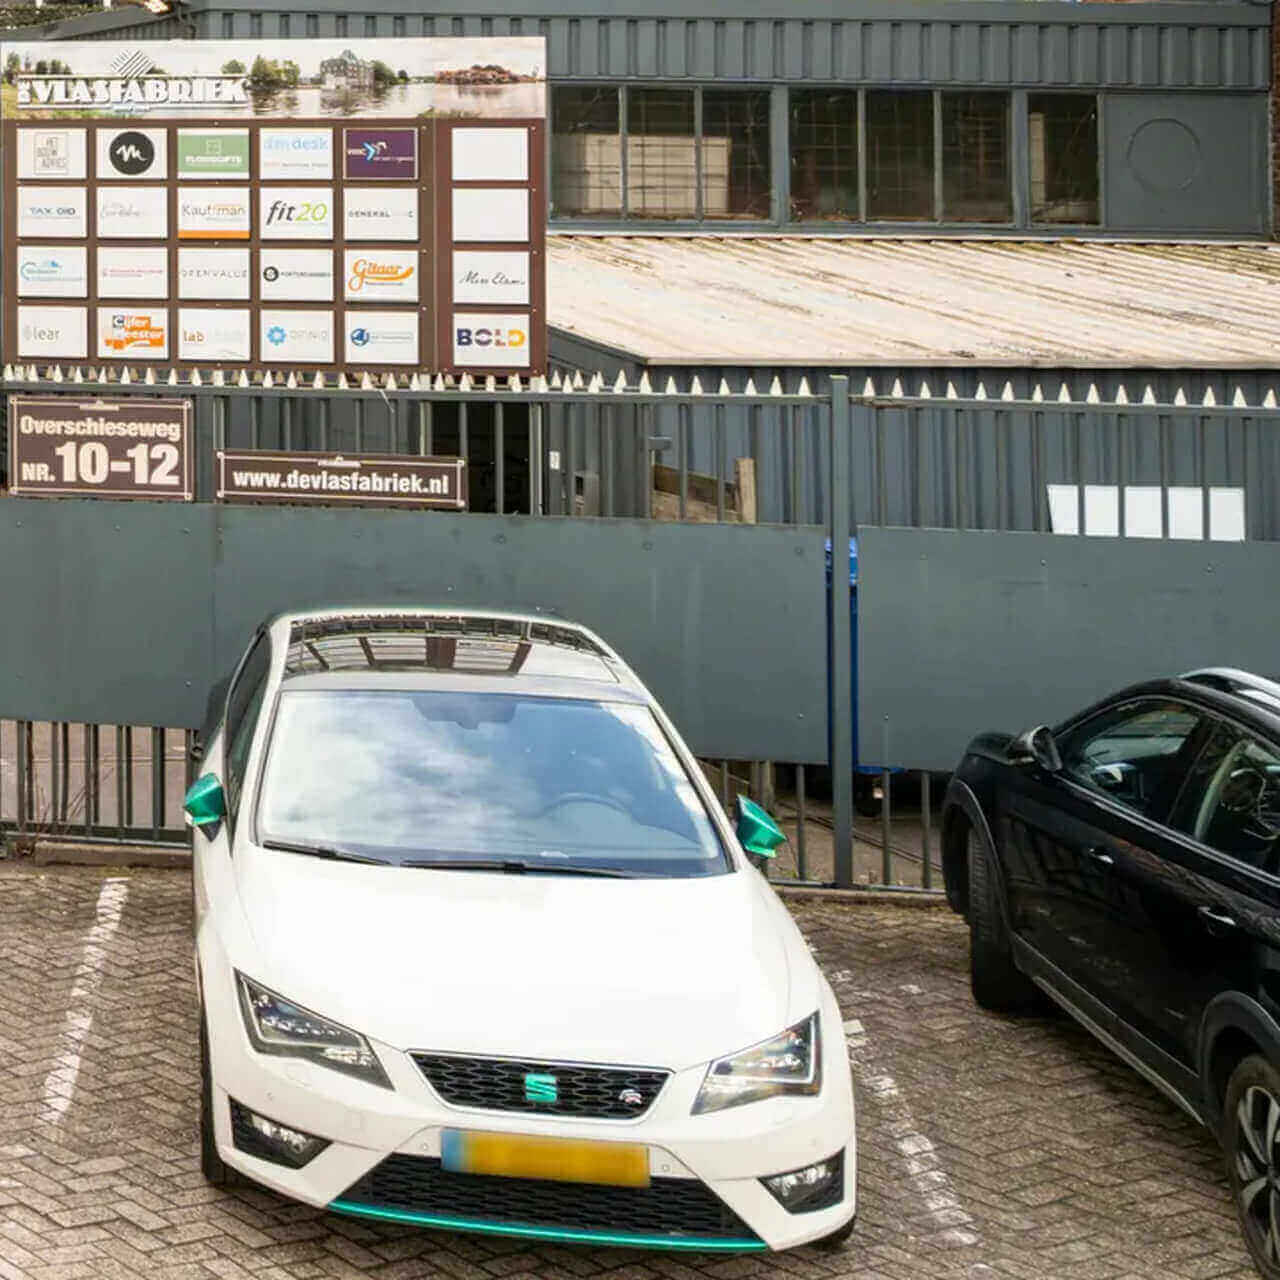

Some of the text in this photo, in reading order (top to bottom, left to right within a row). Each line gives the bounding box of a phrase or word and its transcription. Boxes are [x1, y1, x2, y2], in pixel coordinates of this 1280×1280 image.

[32, 77, 249, 105] VLASFABRIEK
[266, 200, 328, 226] fit20
[456, 327, 526, 347] BOLD
[19, 415, 182, 442] Overschieseweg
[21, 441, 181, 486] NR. 10-12
[232, 469, 450, 495] www.devlasfabriek.nl
